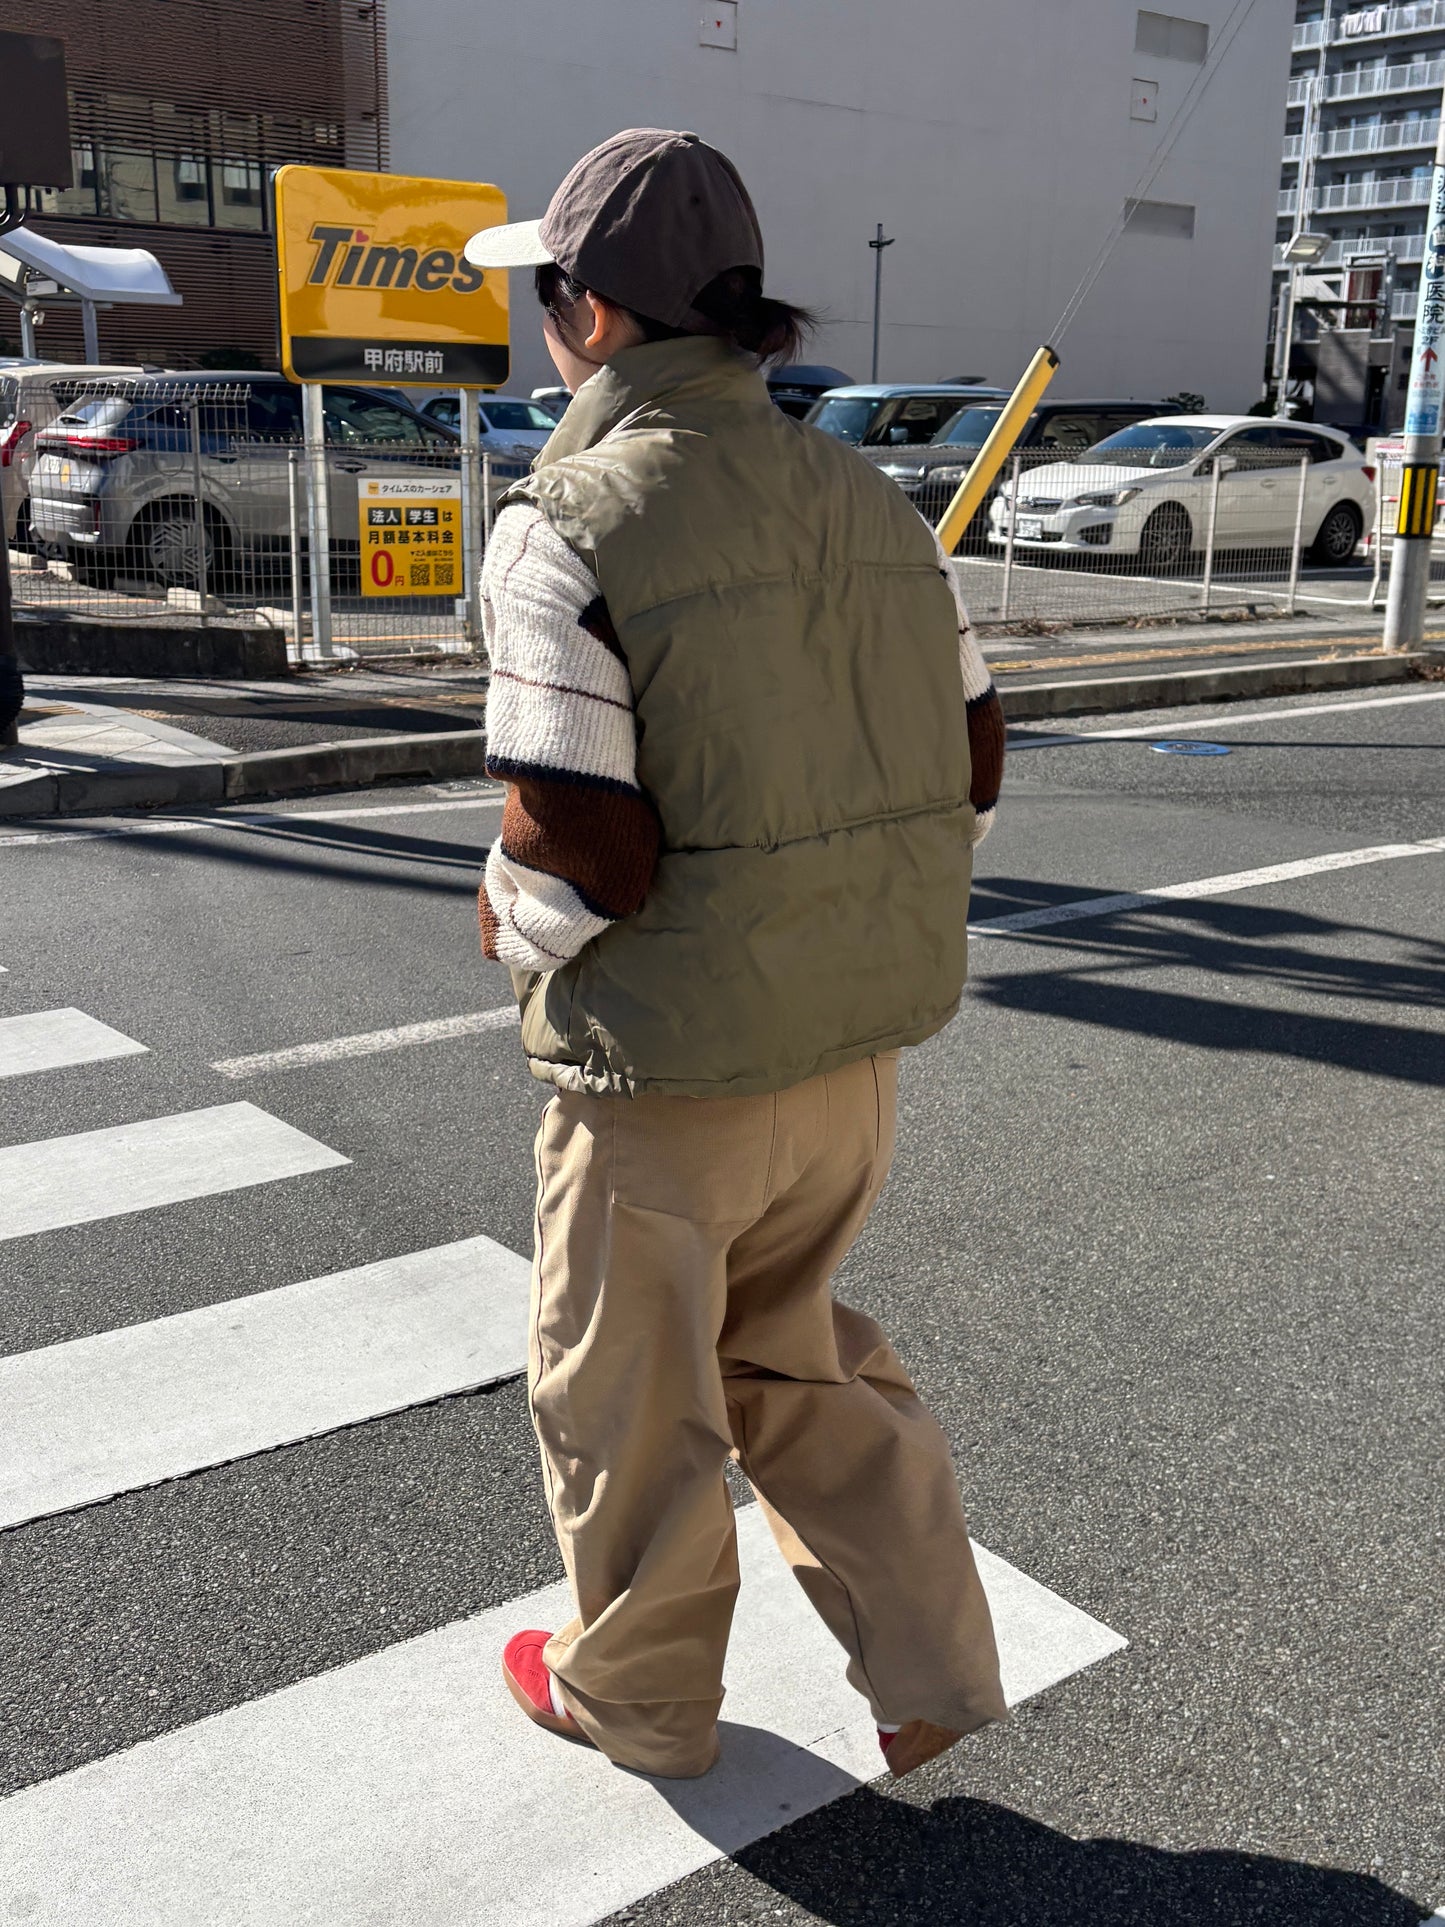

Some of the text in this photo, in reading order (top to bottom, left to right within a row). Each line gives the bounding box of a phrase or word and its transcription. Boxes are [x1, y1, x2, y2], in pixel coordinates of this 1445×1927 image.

[308, 226, 485, 293] Times
[364, 348, 444, 374] 甲府駅前
[381, 484, 453, 494] タイムズのカーシェア
[372, 509, 453, 523] 法人 学生 は
[368, 530, 454, 545] 月額基本料金
